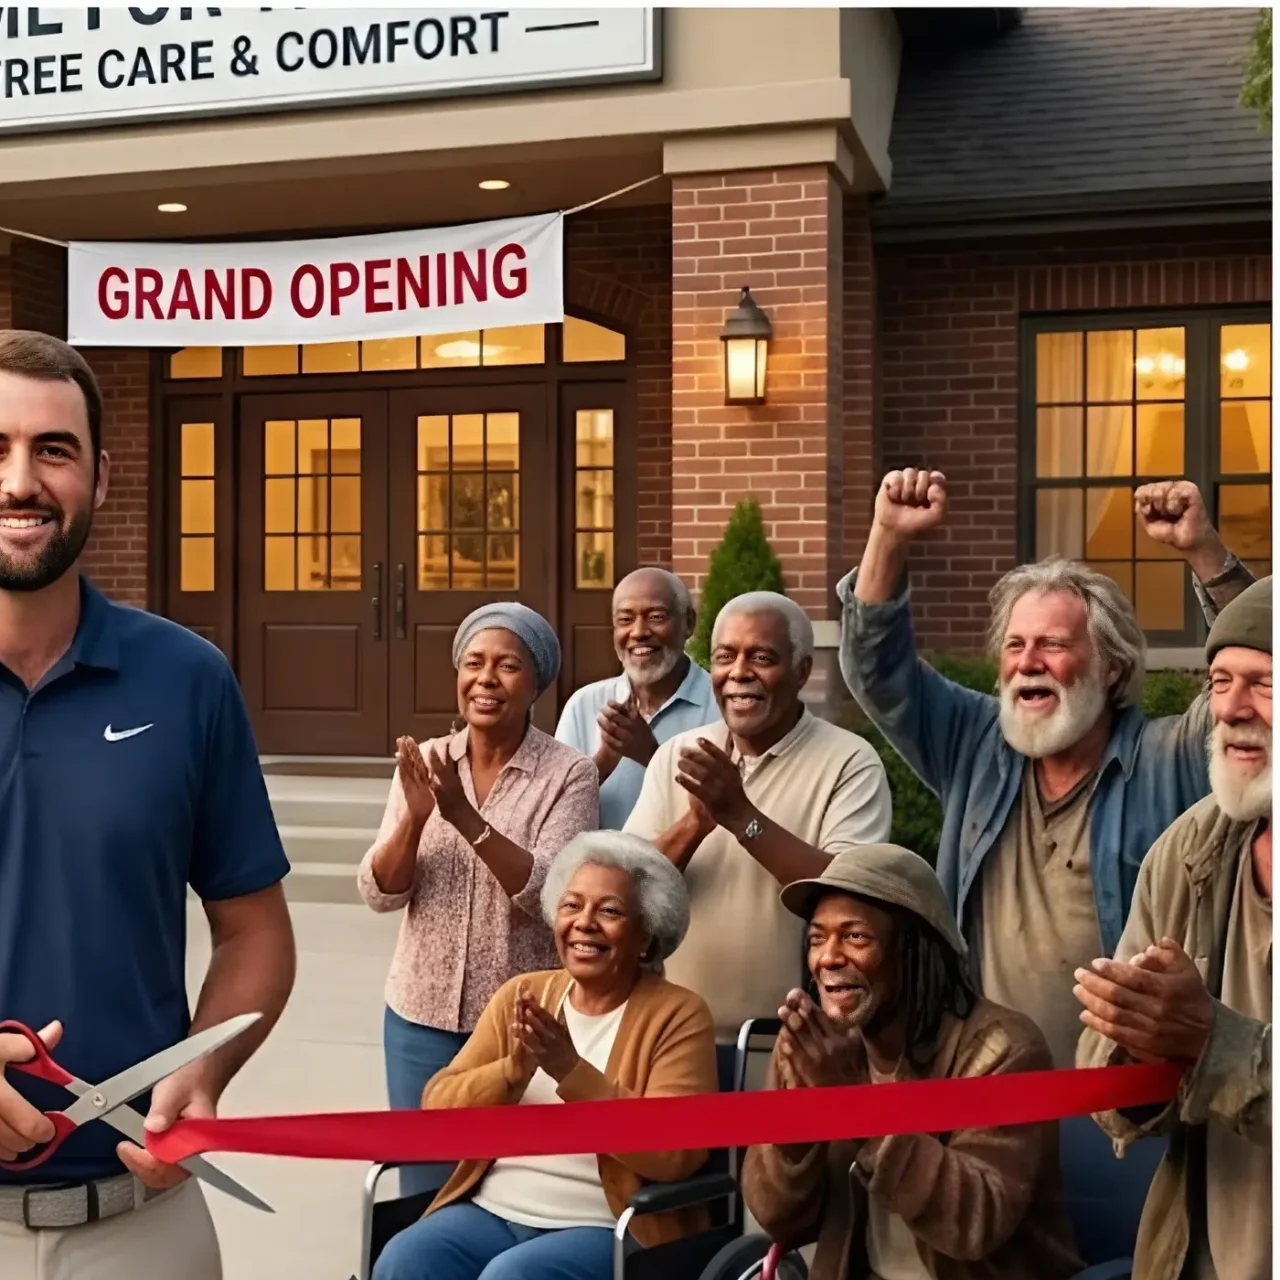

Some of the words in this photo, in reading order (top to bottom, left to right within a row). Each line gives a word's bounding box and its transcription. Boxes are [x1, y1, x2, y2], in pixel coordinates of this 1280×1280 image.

[97, 40, 214, 89] CARE
[230, 35, 259, 77] &
[276, 11, 509, 72] COMFORT
[98, 266, 273, 320] GRAND
[290, 242, 527, 318] OPENING
